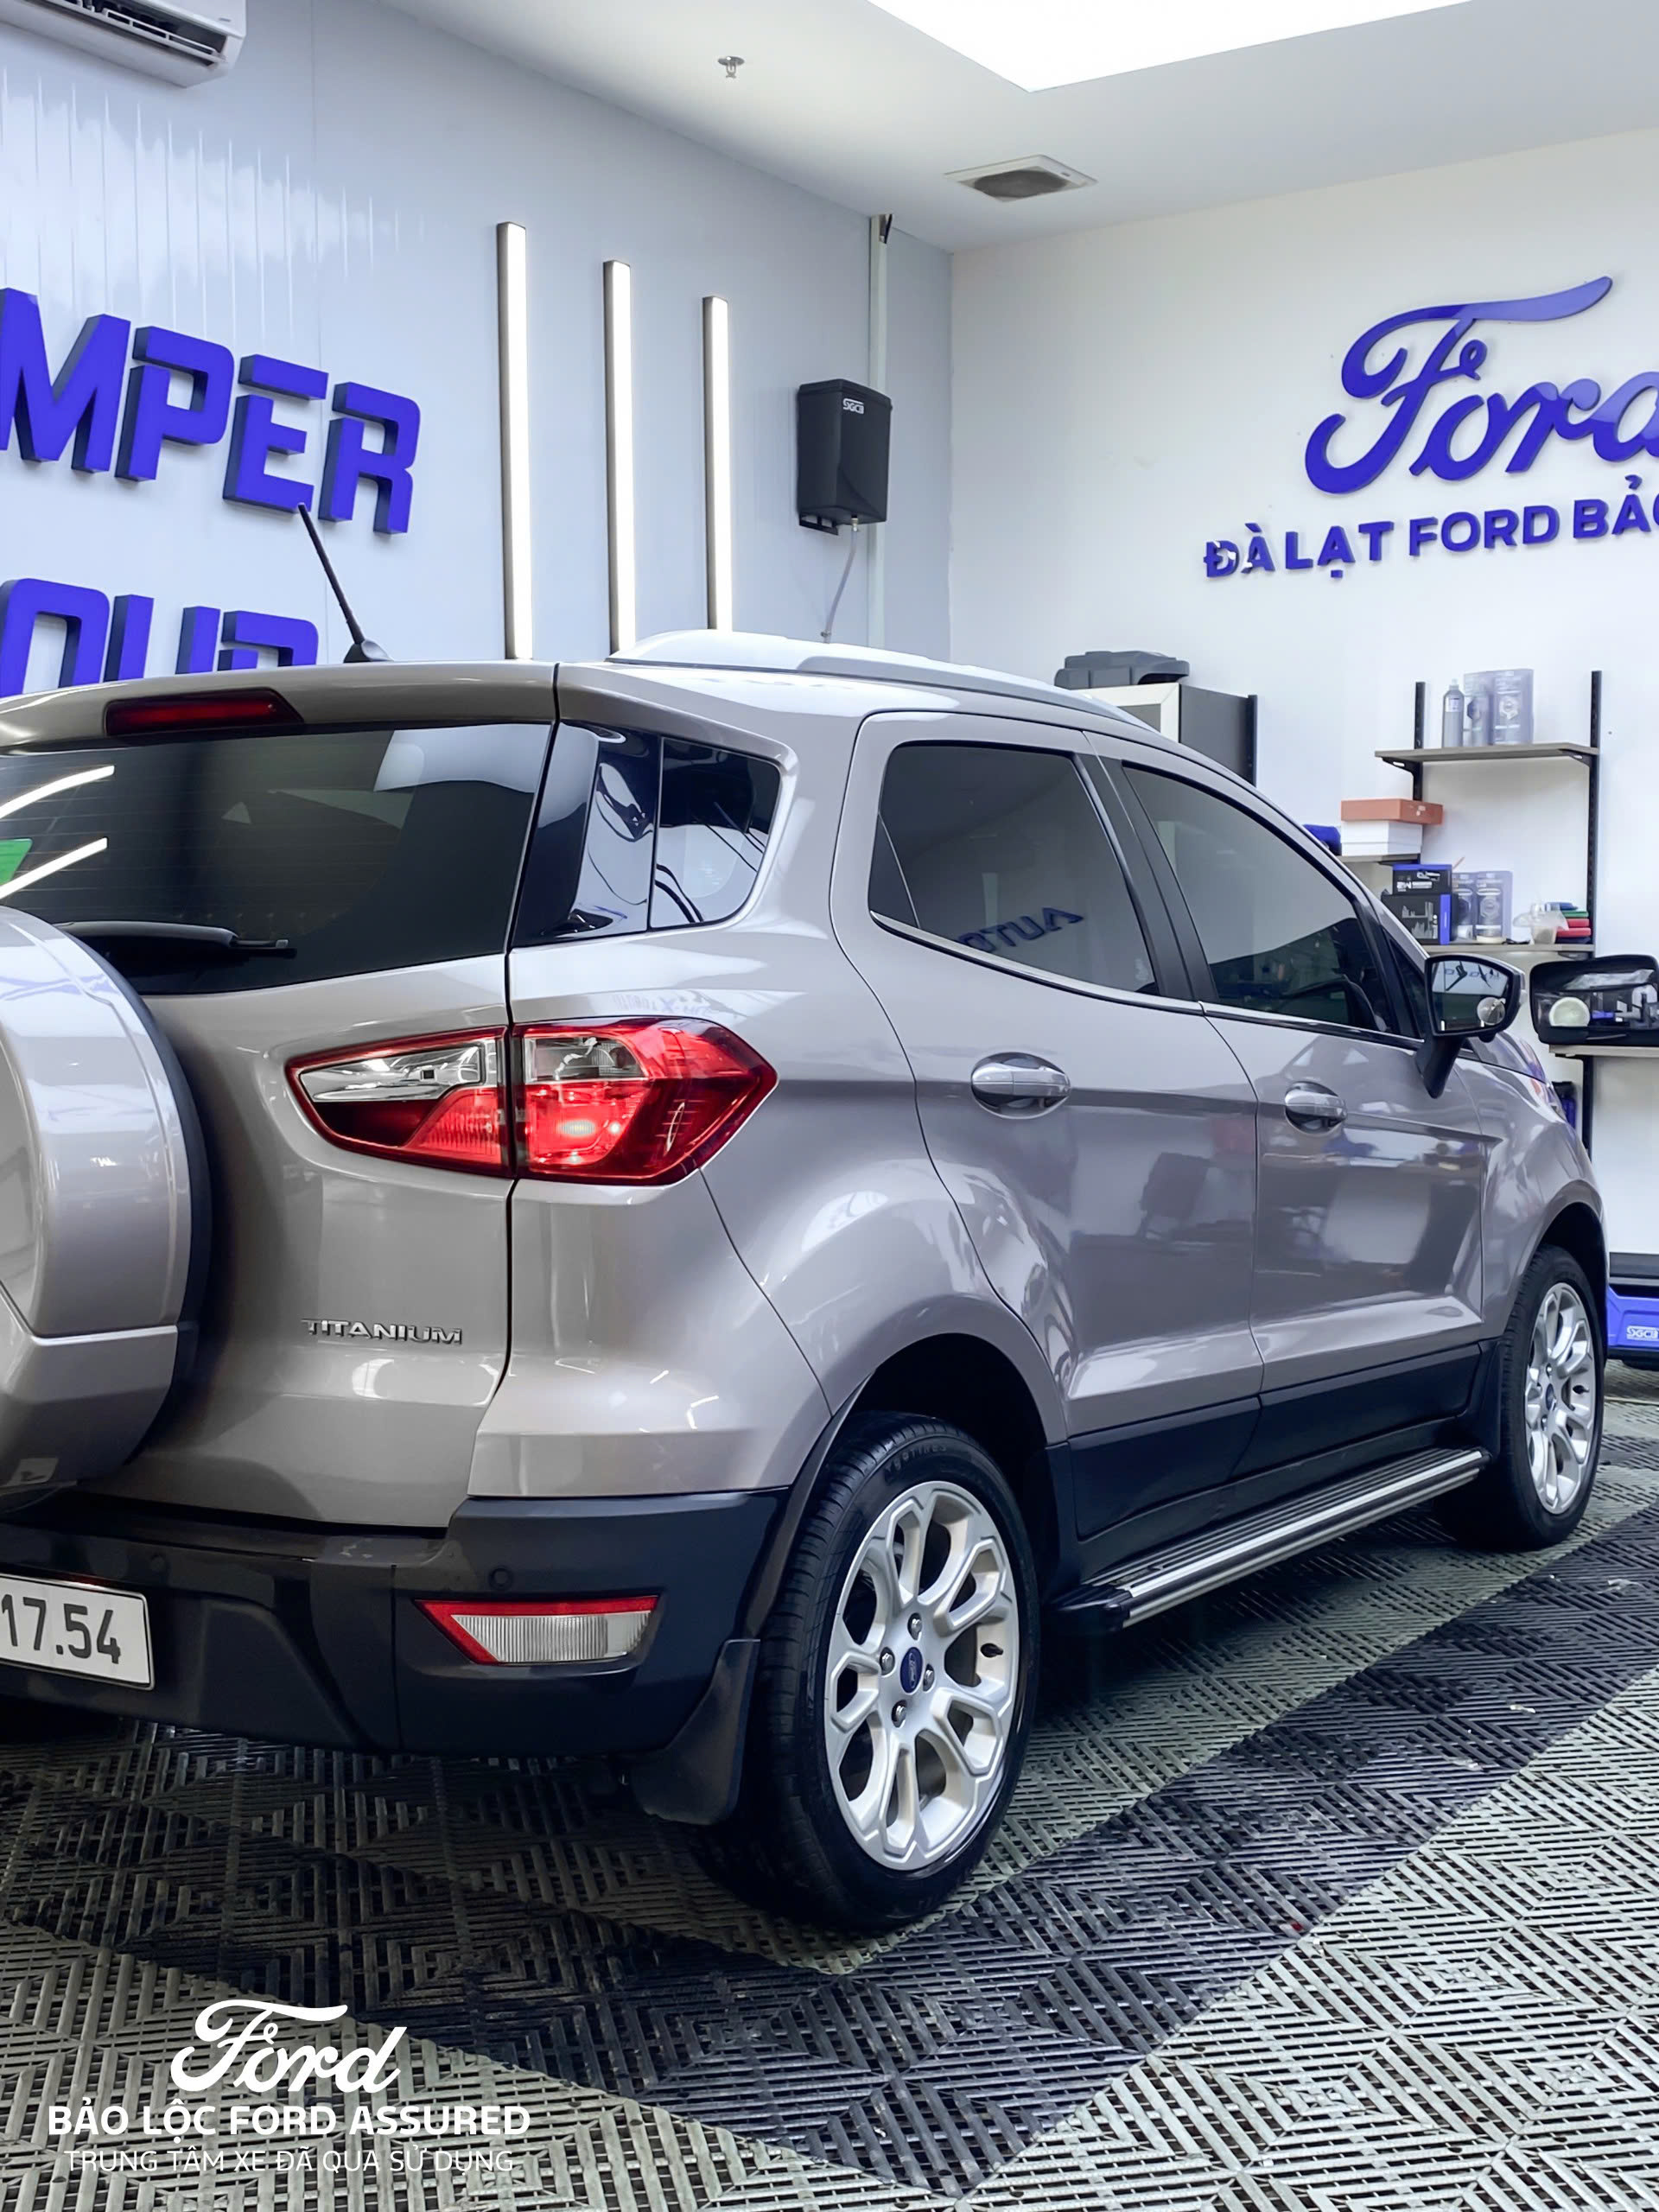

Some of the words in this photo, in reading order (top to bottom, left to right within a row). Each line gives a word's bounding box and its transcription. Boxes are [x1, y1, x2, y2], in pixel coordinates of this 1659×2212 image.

[1204, 522, 1275, 578] ĐÀ
[1285, 520, 1394, 579] LẠT
[1408, 504, 1559, 556] FORD
[1572, 474, 1659, 540] BẢ
[301, 1319, 462, 1345] TITANIUM
